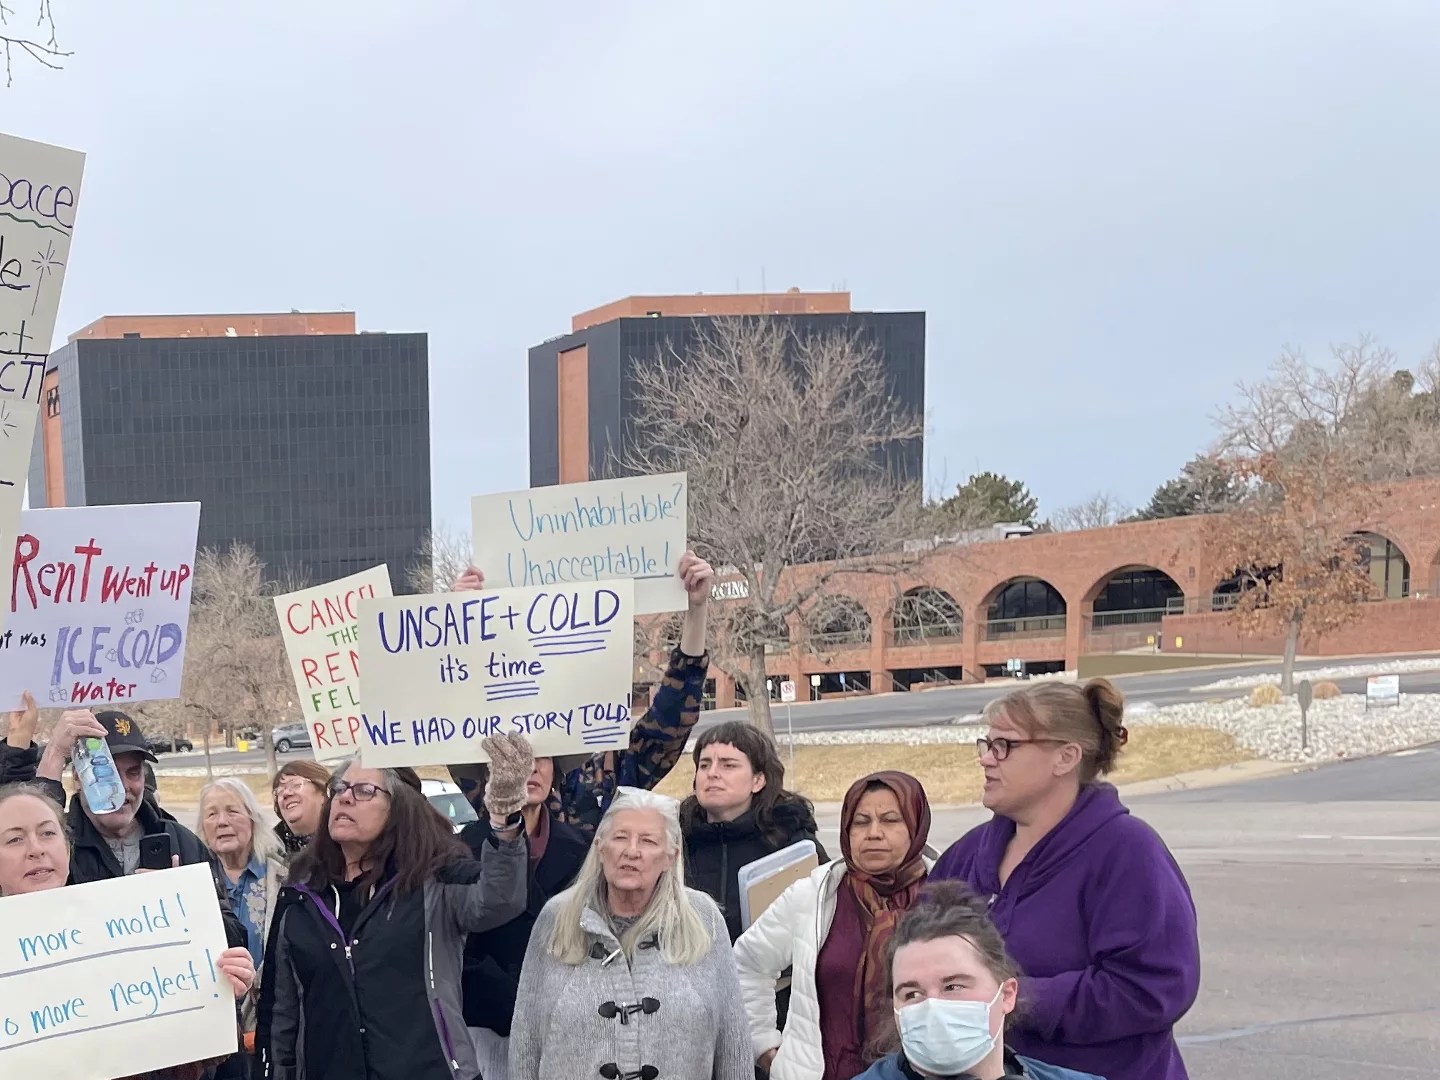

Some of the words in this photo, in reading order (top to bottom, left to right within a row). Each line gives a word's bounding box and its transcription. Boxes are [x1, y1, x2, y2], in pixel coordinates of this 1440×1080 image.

[509, 482, 683, 541] Uninhabitable?
[11, 534, 102, 613] Rent
[379, 596, 500, 653] UNSAFE
[528, 590, 619, 634] COLD
[51, 626, 111, 686] ICE
[117, 622, 182, 669] COLD
[440, 656, 468, 683] it's
[485, 652, 545, 679] time
[362, 710, 406, 746] WE
[413, 719, 455, 745] HAD
[462, 716, 505, 738] OUR
[511, 709, 573, 735] STORY
[19, 927, 83, 962] more
[106, 892, 190, 939] mold!
[30, 996, 89, 1035] more
[110, 948, 220, 1017] neglect!
